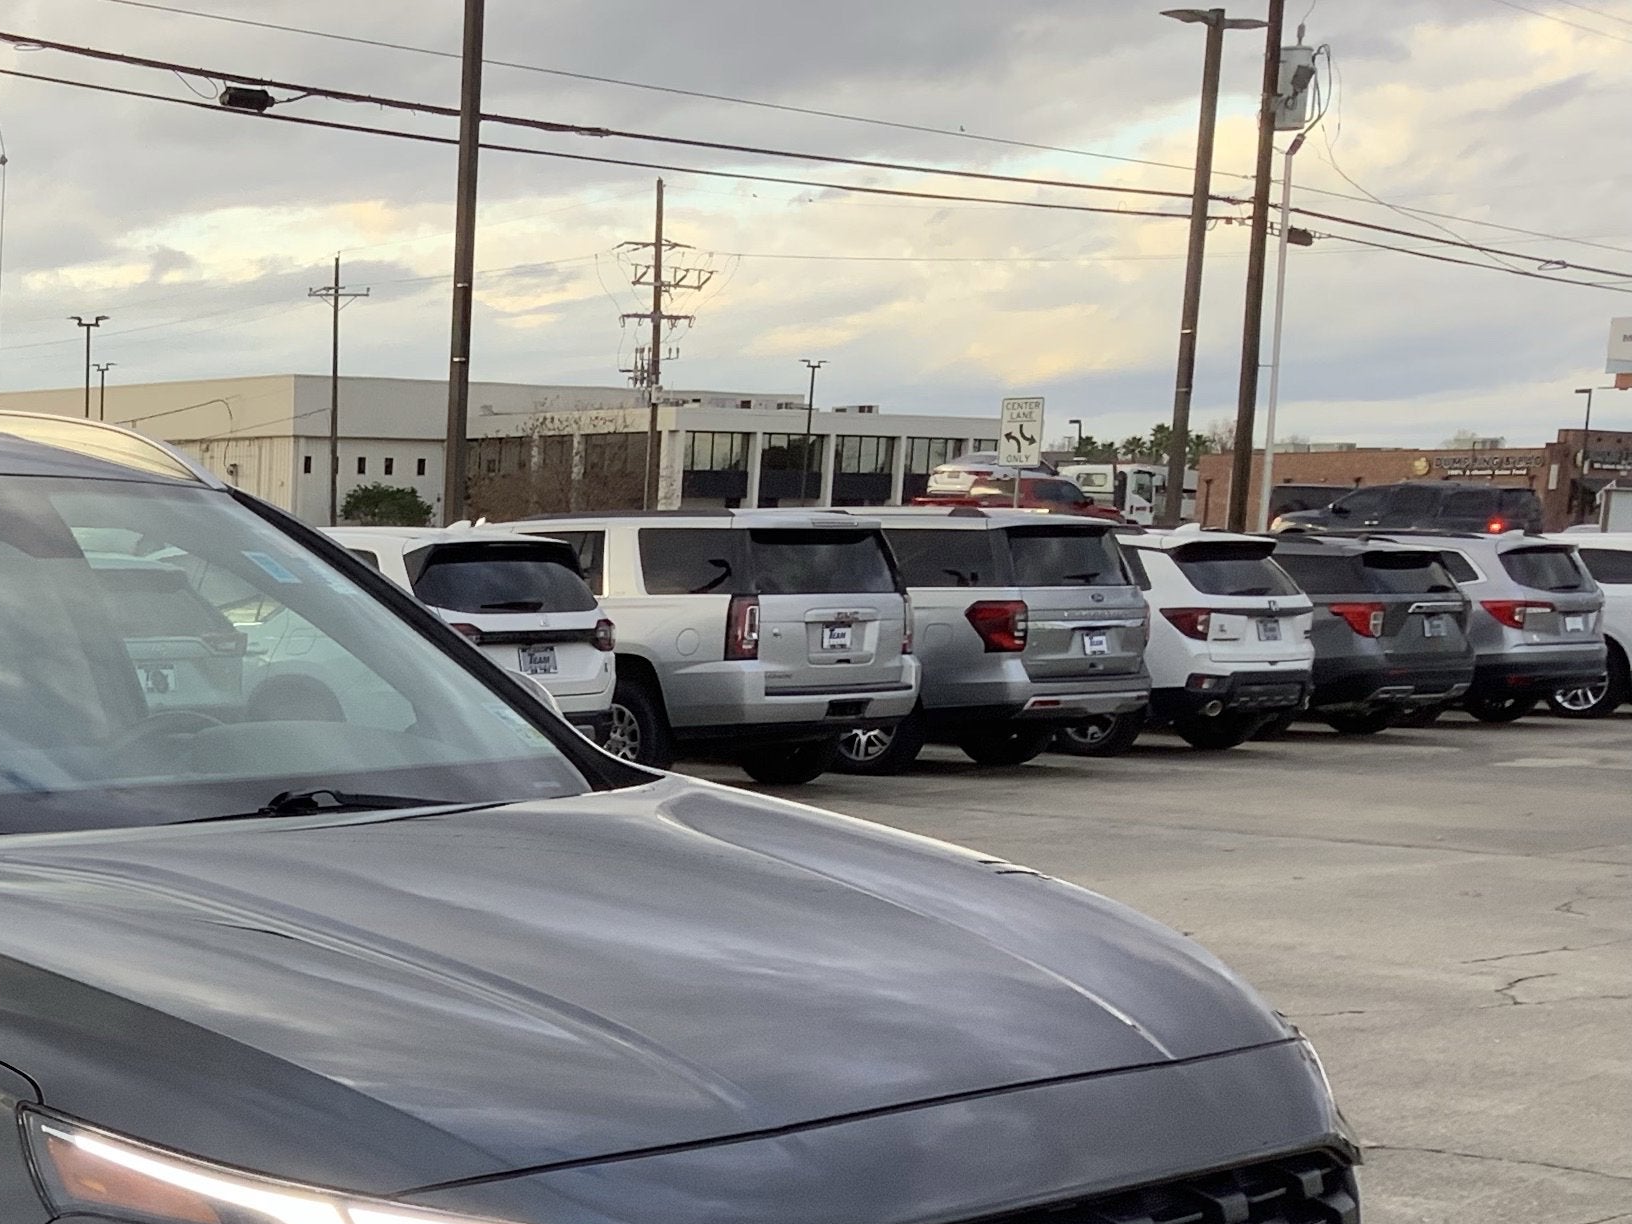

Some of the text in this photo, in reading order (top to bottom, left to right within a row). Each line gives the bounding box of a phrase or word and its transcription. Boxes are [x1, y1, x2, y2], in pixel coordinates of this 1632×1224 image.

[1006, 401, 1041, 411] CENTER
[1010, 411, 1033, 420] LANE
[1006, 453, 1031, 463] ONLY
